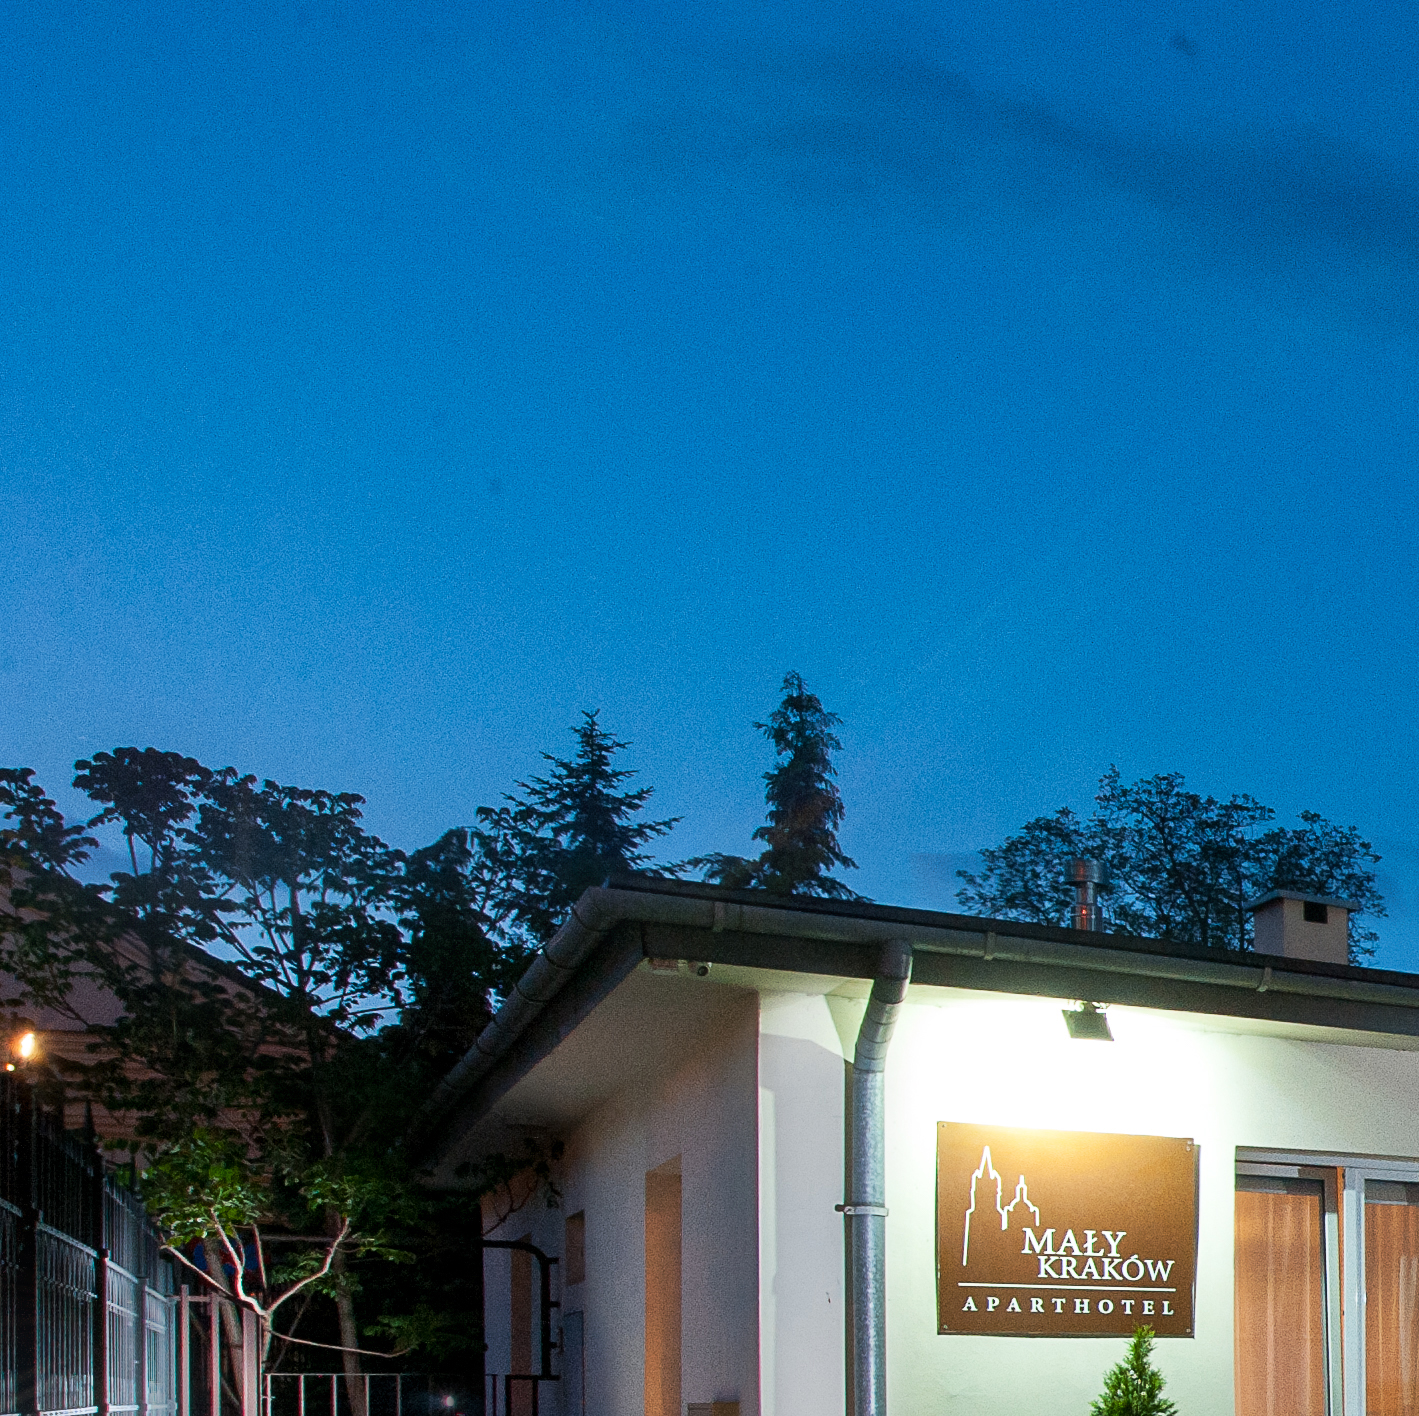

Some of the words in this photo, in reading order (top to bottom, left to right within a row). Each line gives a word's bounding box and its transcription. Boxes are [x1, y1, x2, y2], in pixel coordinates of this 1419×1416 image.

[1021, 1227, 1126, 1257] MAŁY
[1037, 1254, 1175, 1282] KRAKÓW
[962, 1296, 1174, 1315] APARTHOTEL
